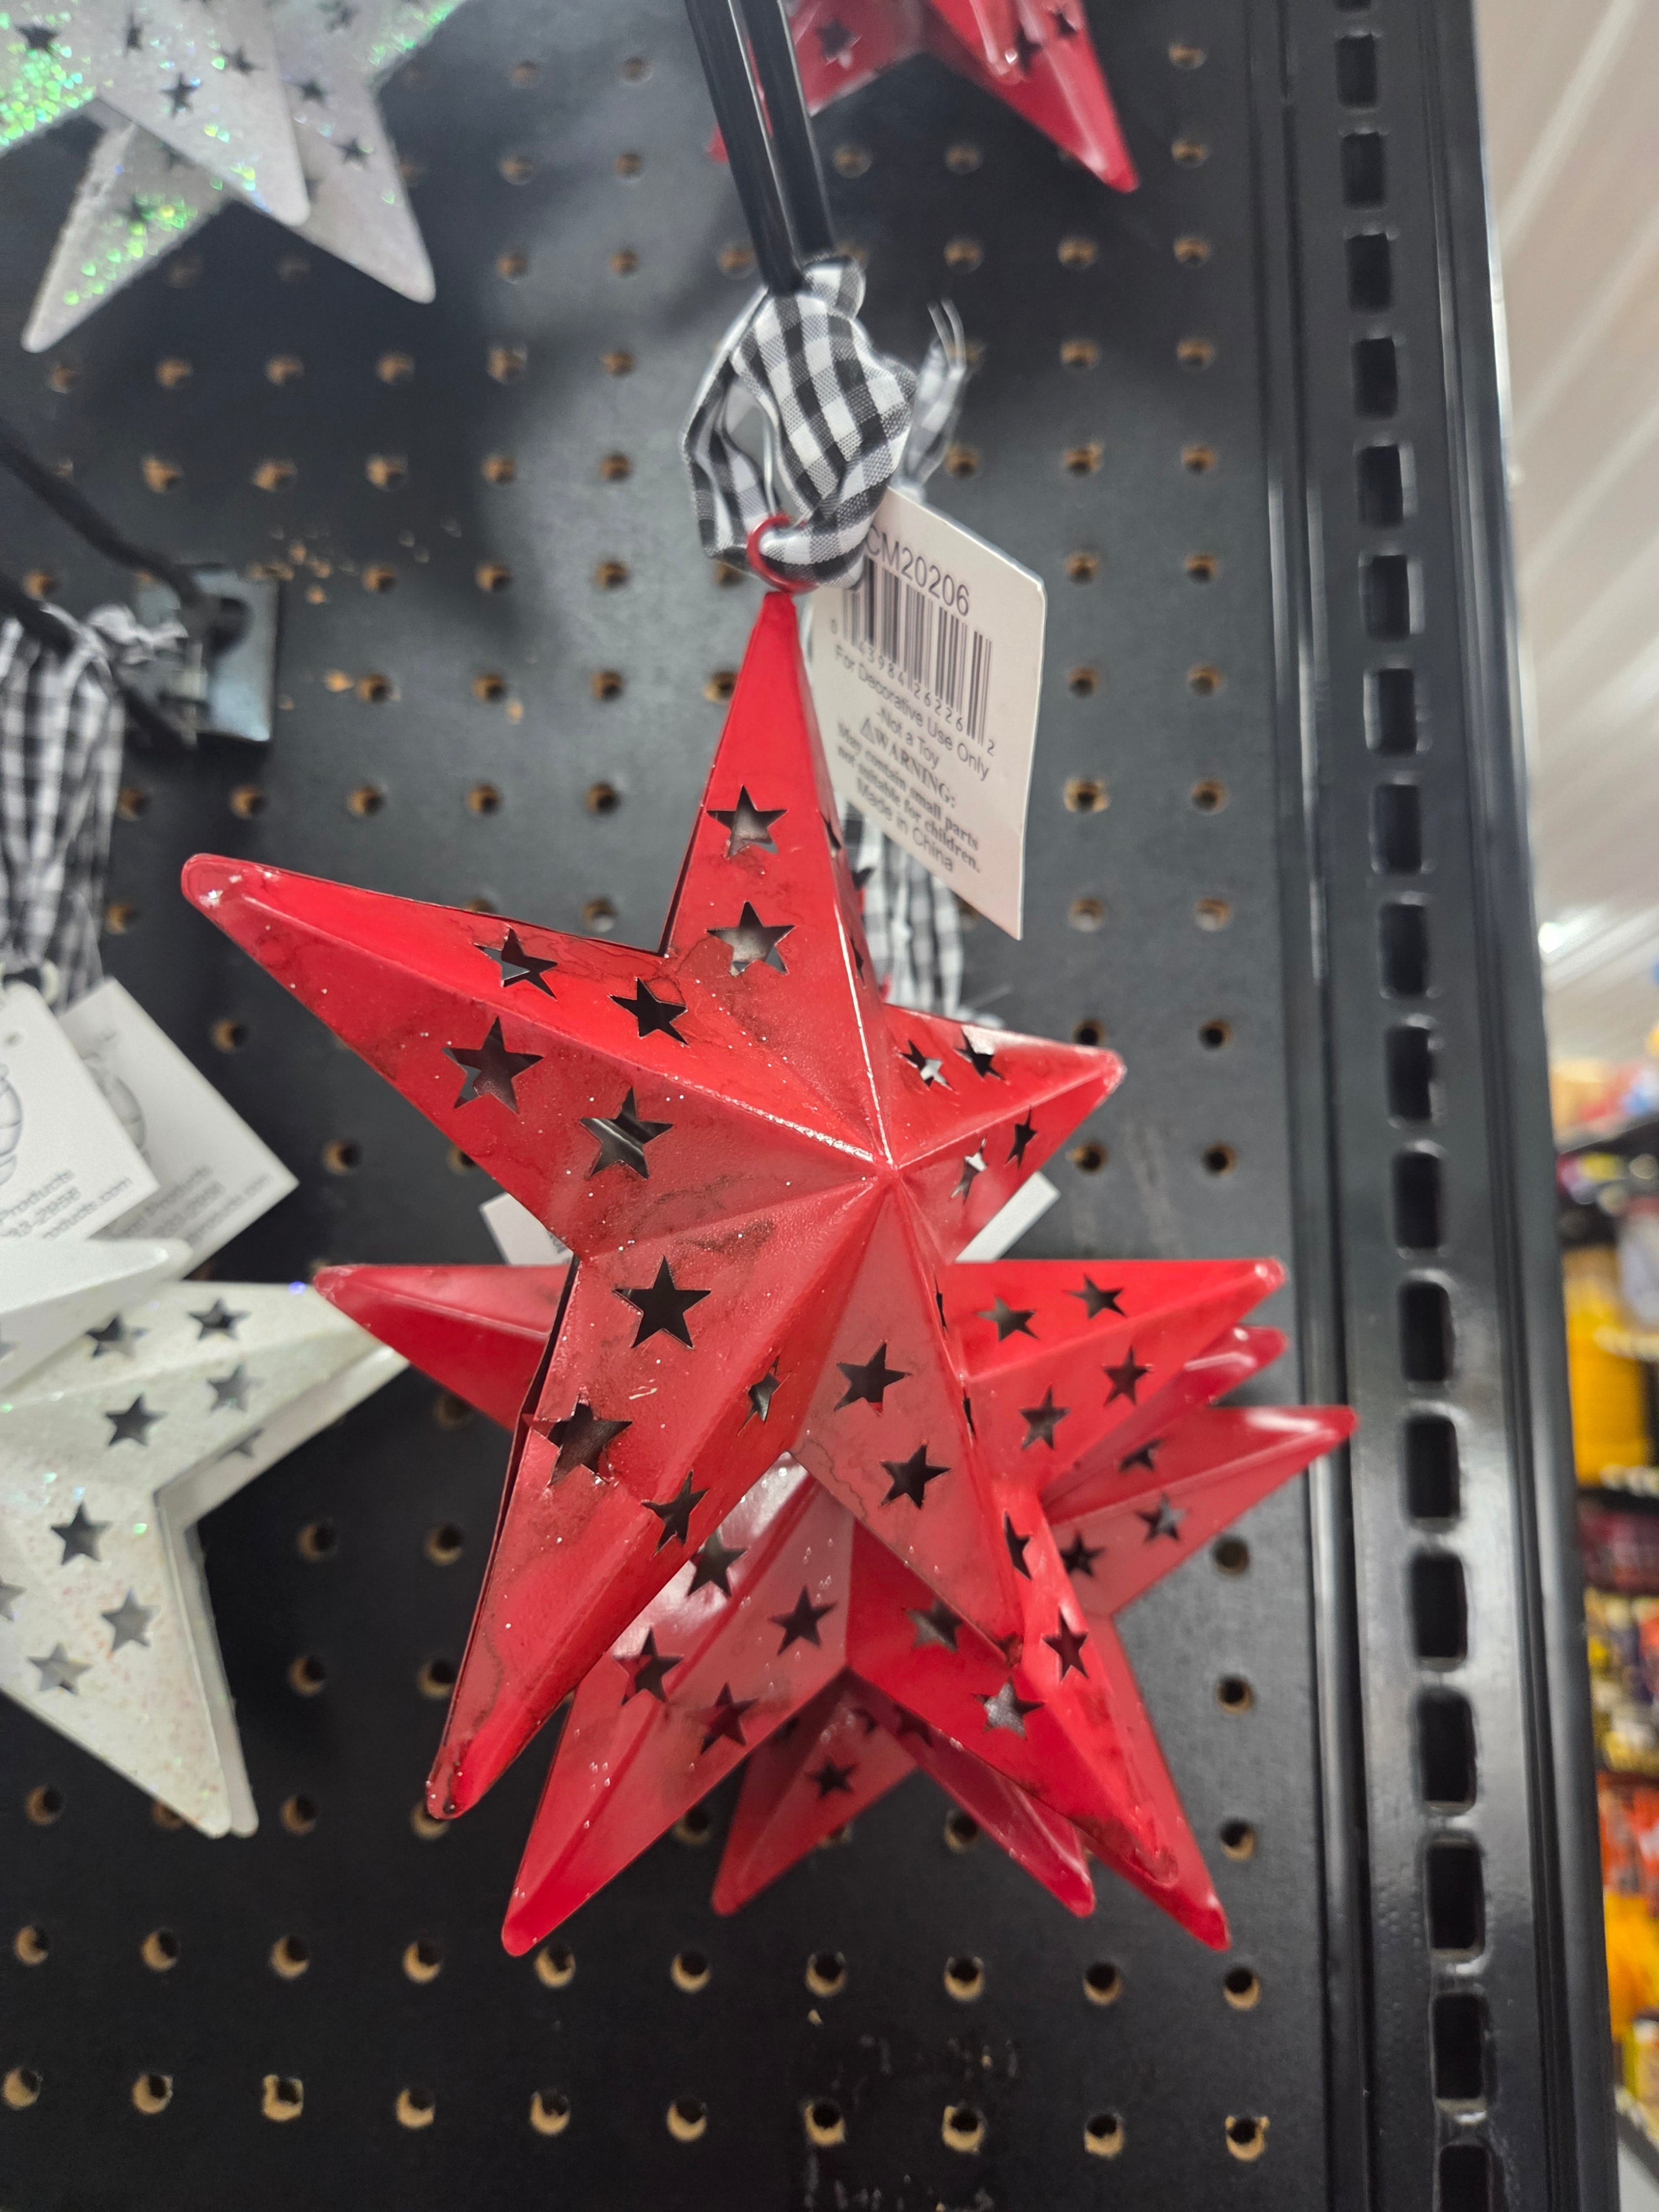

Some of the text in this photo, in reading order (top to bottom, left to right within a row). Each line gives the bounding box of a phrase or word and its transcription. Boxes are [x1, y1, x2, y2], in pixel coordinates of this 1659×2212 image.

[866, 525, 969, 617] CM20206
[836, 644, 989, 781] For Decorative Use Only
[906, 732, 913, 746] a
[917, 735, 939, 770] Toy
[914, 682, 963, 732] 26226
[987, 739, 995, 757] 2
[838, 722, 978, 851] May contain small parts
[874, 727, 956, 808] WARNING:
[857, 777, 953, 873] Made in China
[858, 764, 900, 807] suitable
[904, 800, 921, 823] for
[925, 820, 980, 873] children.
